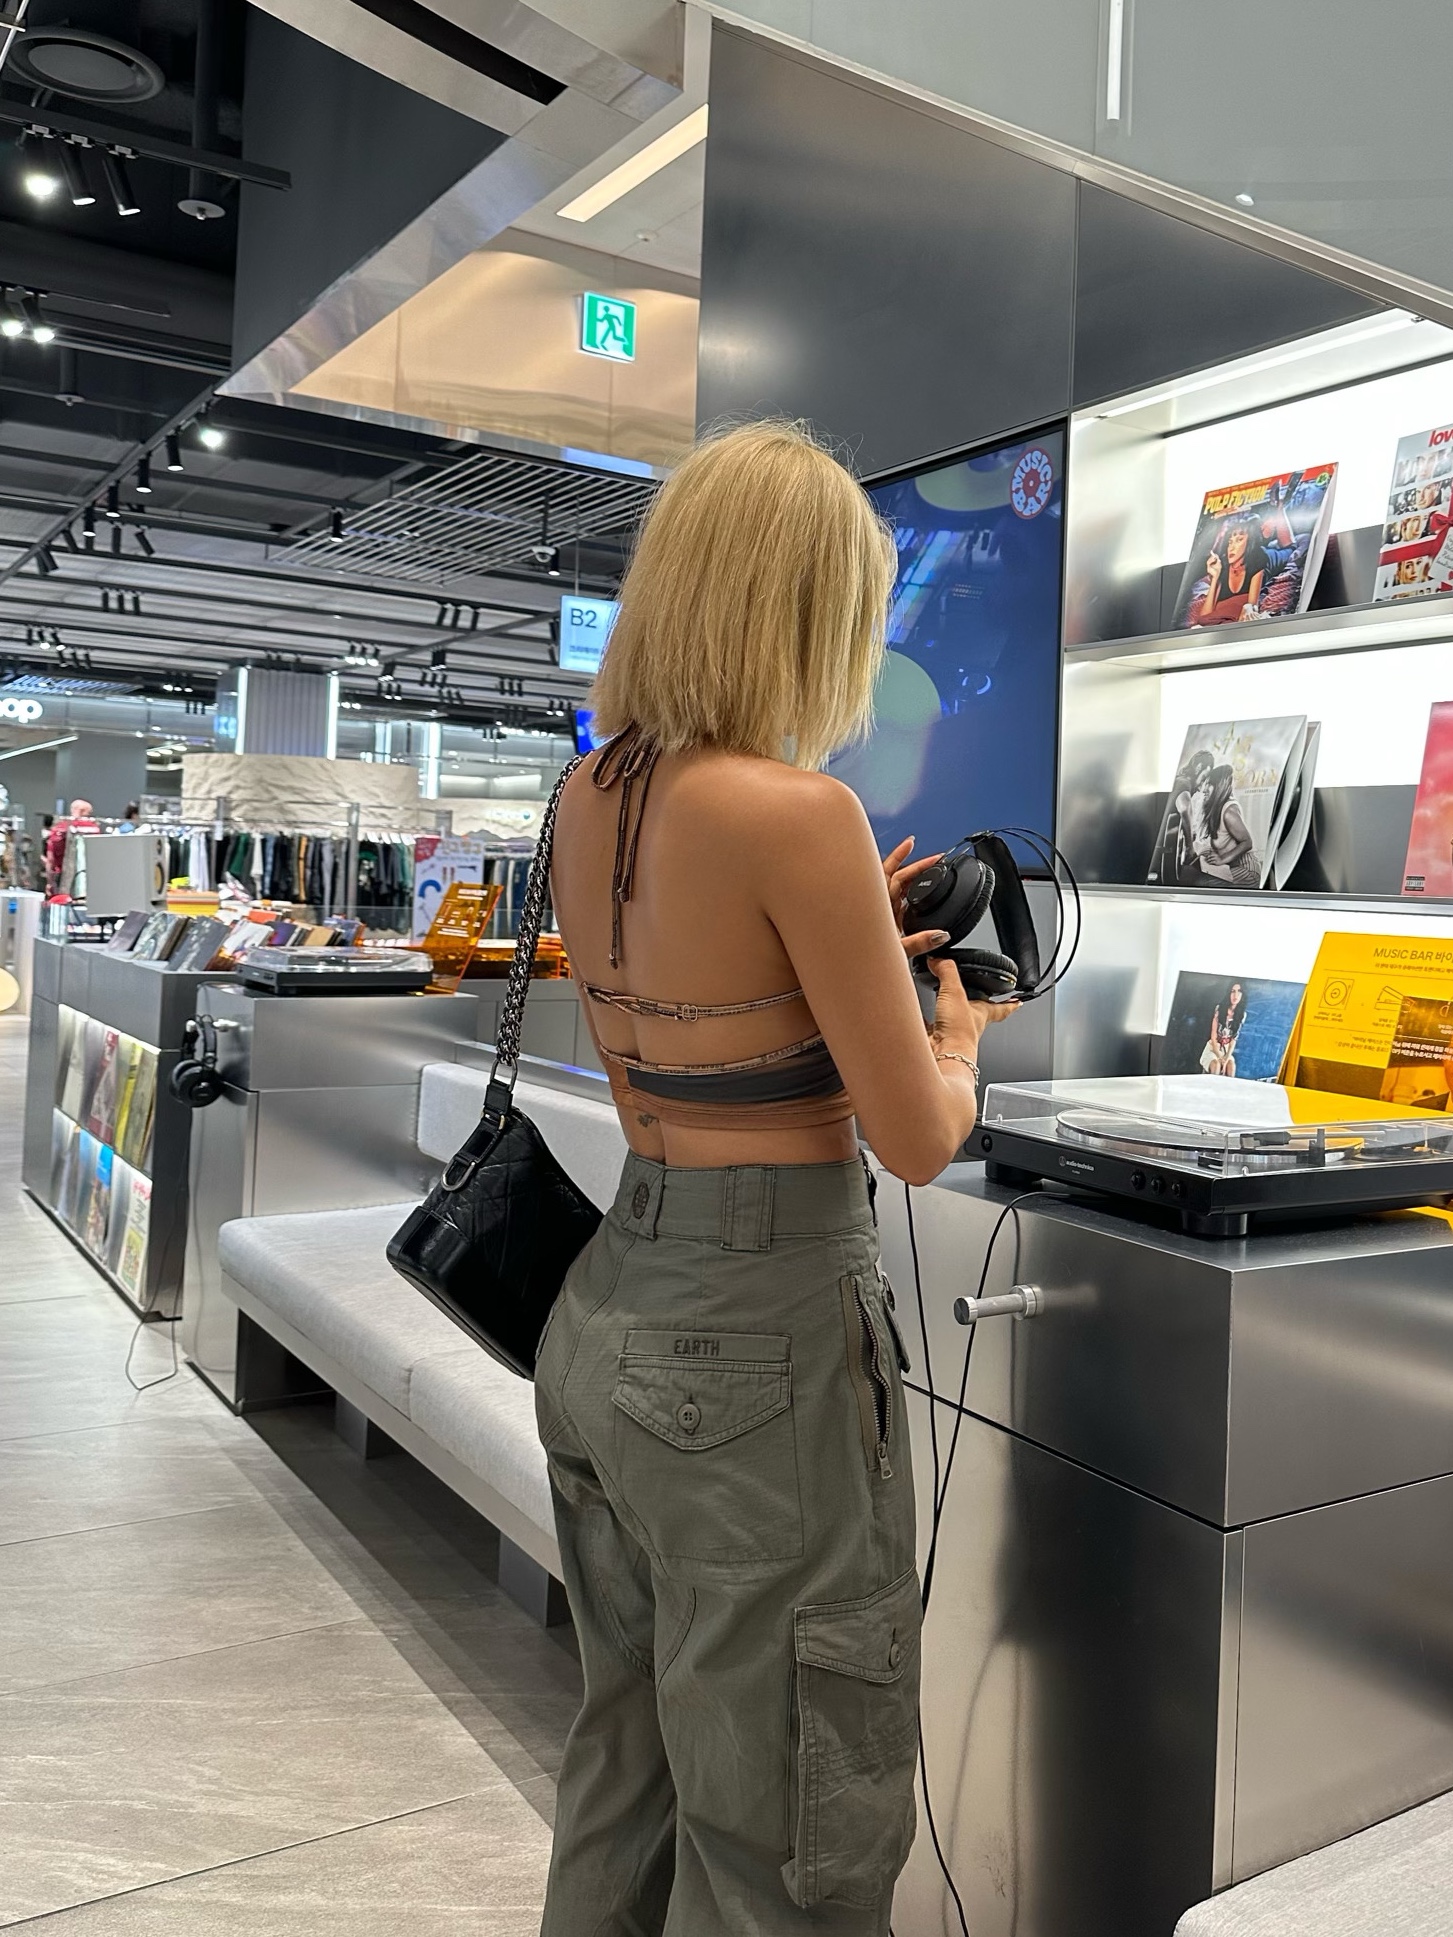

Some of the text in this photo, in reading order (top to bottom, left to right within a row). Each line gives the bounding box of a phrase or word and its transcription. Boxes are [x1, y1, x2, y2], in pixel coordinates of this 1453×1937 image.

[1012, 450, 1053, 516] MUSIC BAR
[1203, 493, 1230, 515] PULP
[1229, 484, 1269, 508] FICTION
[570, 608, 597, 629] B2
[0, 697, 43, 724] op
[1373, 947, 1409, 960] MUSIC
[1409, 950, 1434, 961] BAR
[674, 1339, 720, 1356] EARTH
